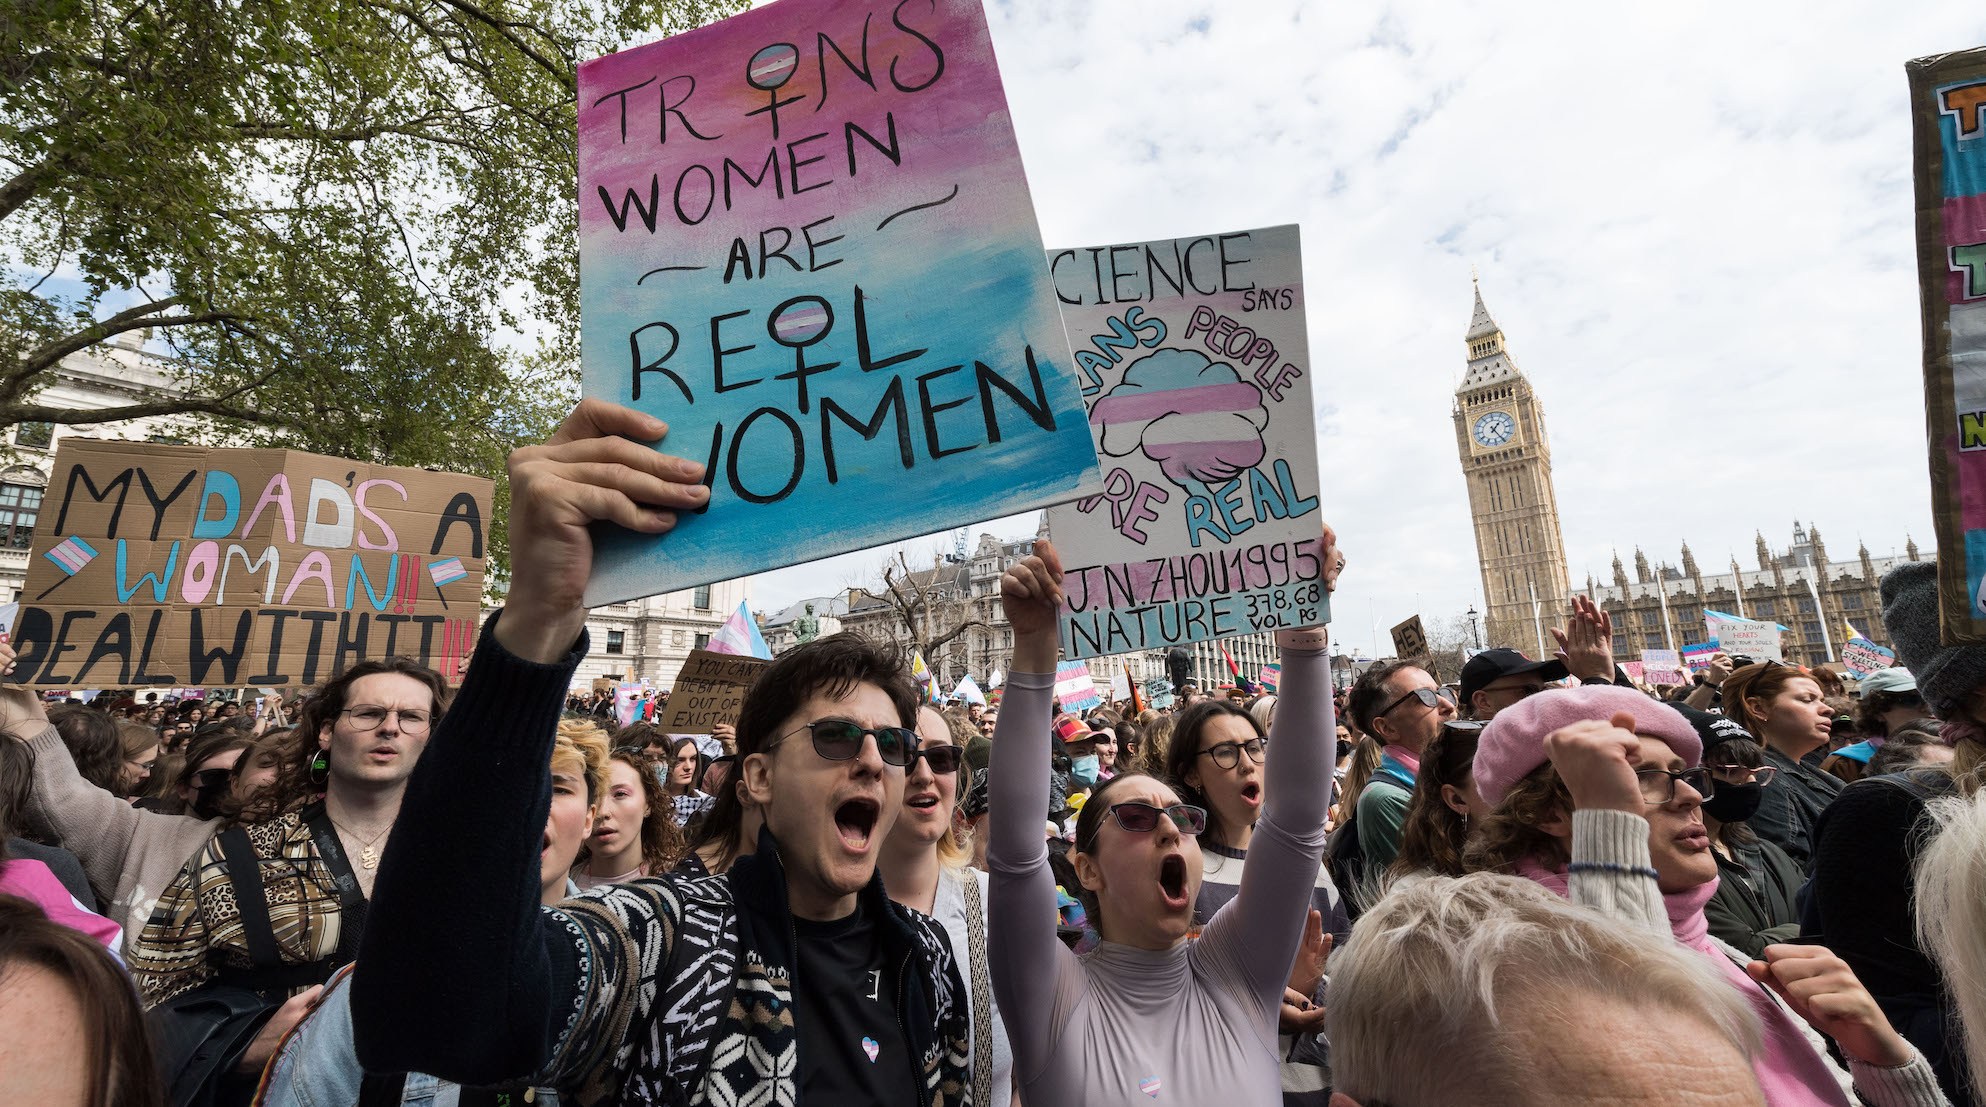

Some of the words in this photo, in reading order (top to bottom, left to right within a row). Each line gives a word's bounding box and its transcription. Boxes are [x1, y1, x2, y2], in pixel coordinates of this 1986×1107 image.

[597, 112, 901, 234] WOMEN
[723, 215, 846, 284] ARE
[1051, 233, 1256, 305] CIENCE
[1242, 288, 1294, 312] SAYS
[1075, 306, 1168, 397] ANS
[1185, 306, 1302, 402] PEOPLE
[54, 463, 198, 541] MY
[191, 470, 408, 552] DAD'S
[430, 492, 483, 558] A
[1077, 467, 1169, 545] RE
[1184, 459, 1320, 547] REAL
[2, 607, 177, 684] DEAL
[189, 608, 370, 685] WITH
[1070, 597, 1237, 657] NATURE
[1246, 584, 1320, 618] 378,68
[1250, 615, 1291, 631] VOL
[1299, 608, 1318, 625] PG
[680, 677, 737, 694] DEBATE
[696, 659, 723, 676] YOU
[1645, 672, 1681, 684] LOVED
[672, 711, 739, 726] EXISTAN
[688, 697, 717, 709] OUT
[720, 698, 741, 710] OF
